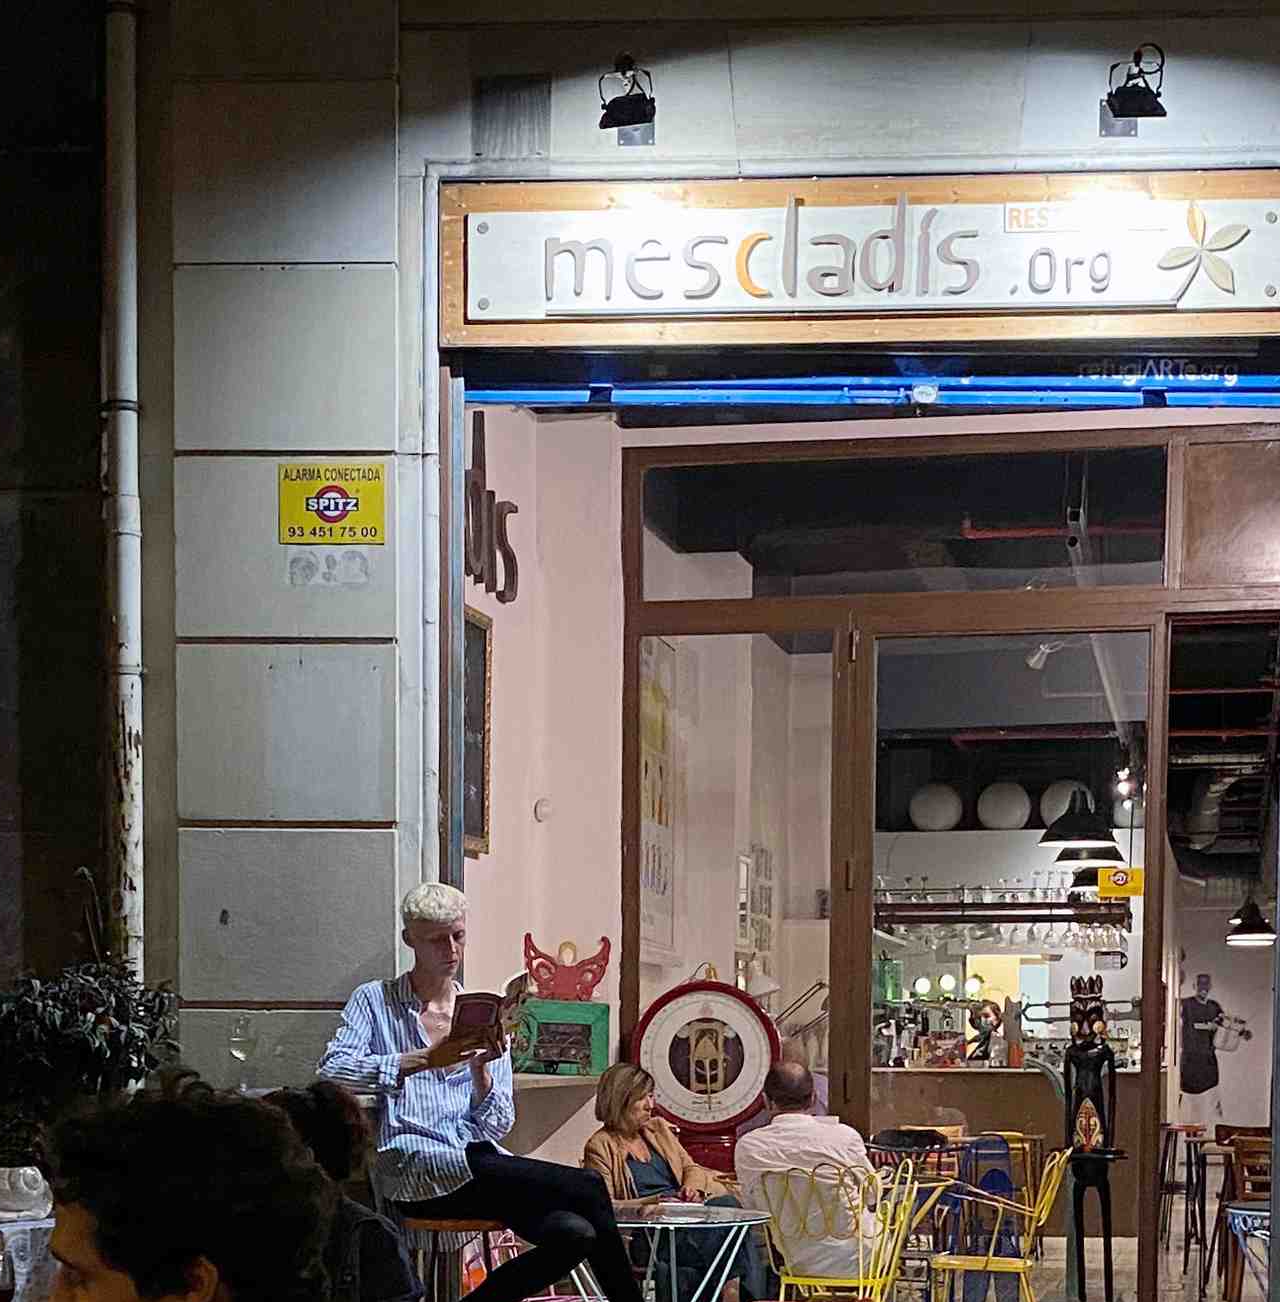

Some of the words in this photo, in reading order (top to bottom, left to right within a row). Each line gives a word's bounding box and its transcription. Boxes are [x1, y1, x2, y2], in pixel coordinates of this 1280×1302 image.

[283, 468, 322, 482] ALARMA
[323, 468, 381, 482] CONECTADA
[306, 498, 359, 512] SPITZ
[287, 526, 305, 538] 93
[309, 526, 333, 538] 451
[339, 526, 357, 538] 75
[360, 526, 378, 538] 00
